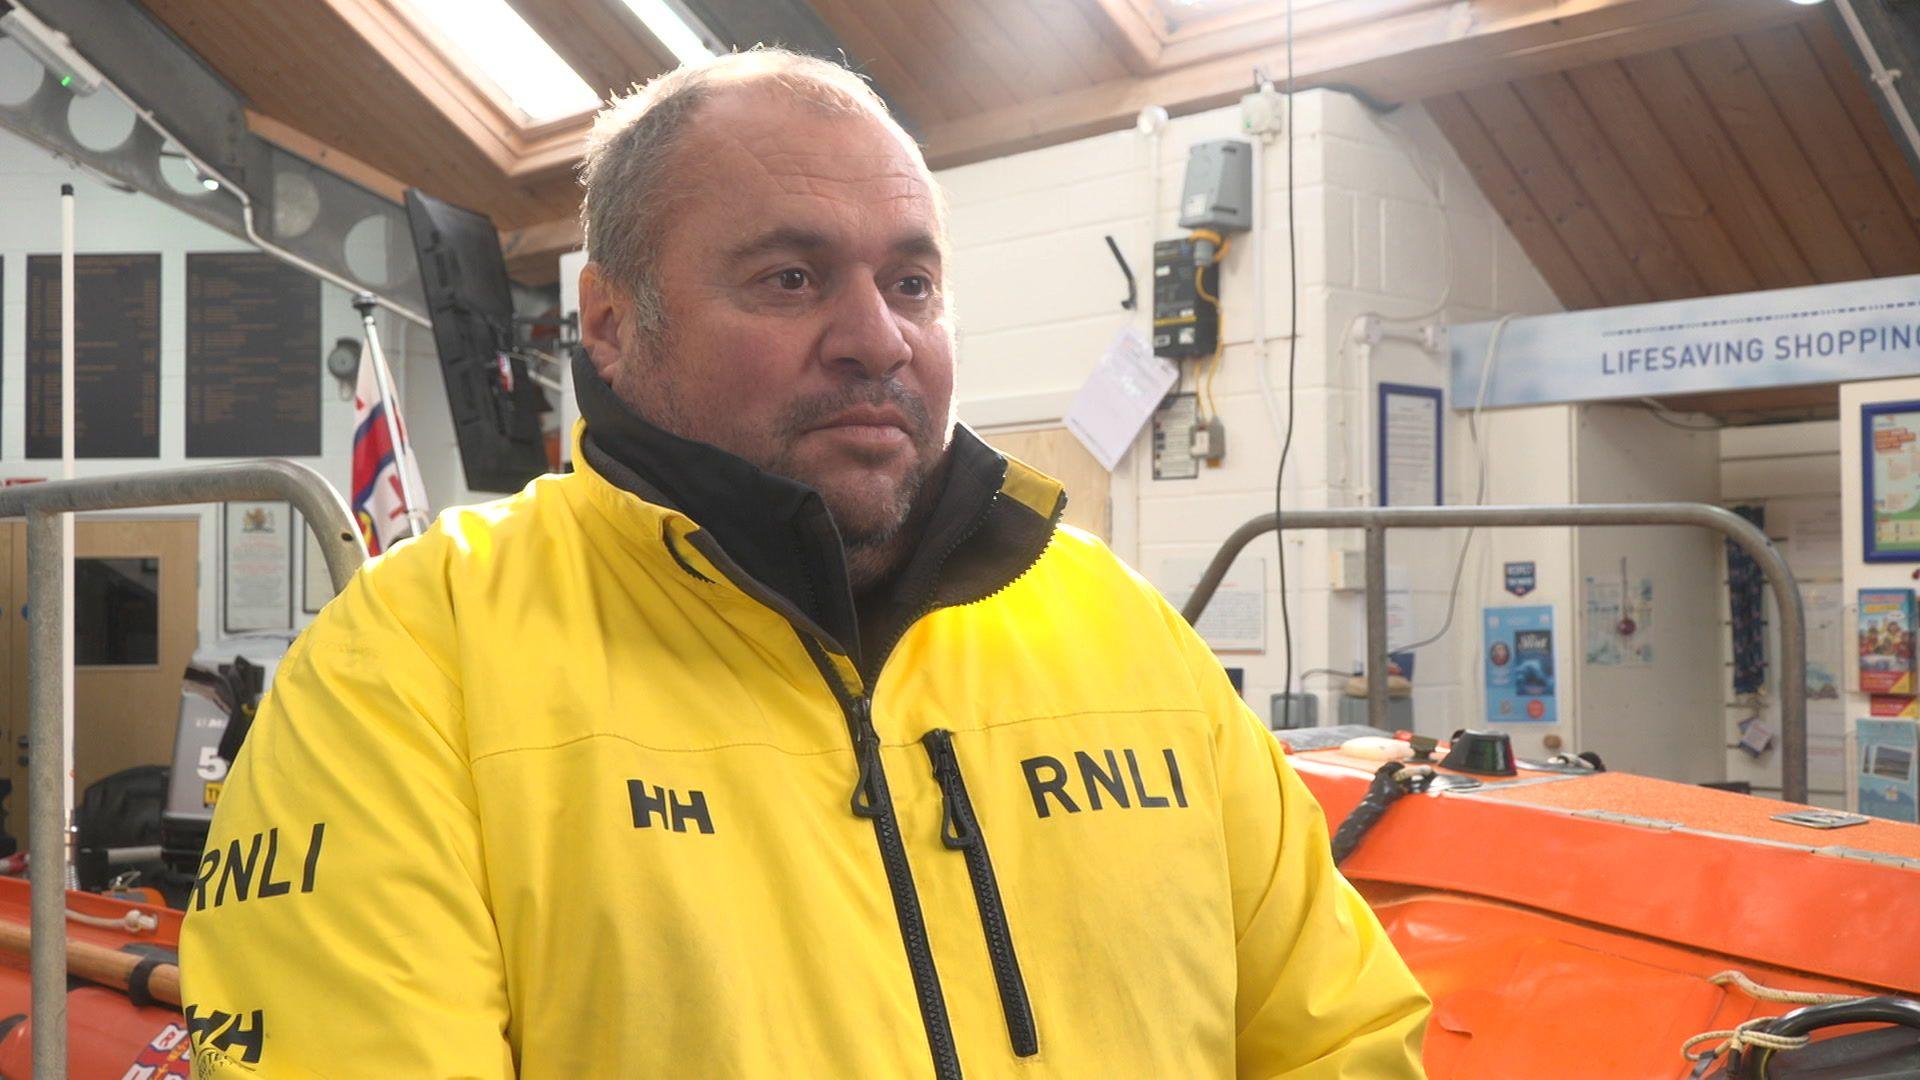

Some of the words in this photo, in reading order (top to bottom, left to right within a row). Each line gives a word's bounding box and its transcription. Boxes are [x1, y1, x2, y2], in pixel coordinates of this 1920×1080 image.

[1602, 338, 1764, 375] LIFESAVING
[1774, 322, 1920, 361] SHOPPIN
[628, 780, 714, 833] HH
[1021, 750, 1186, 817] RNLI
[188, 822, 325, 911] RNLI
